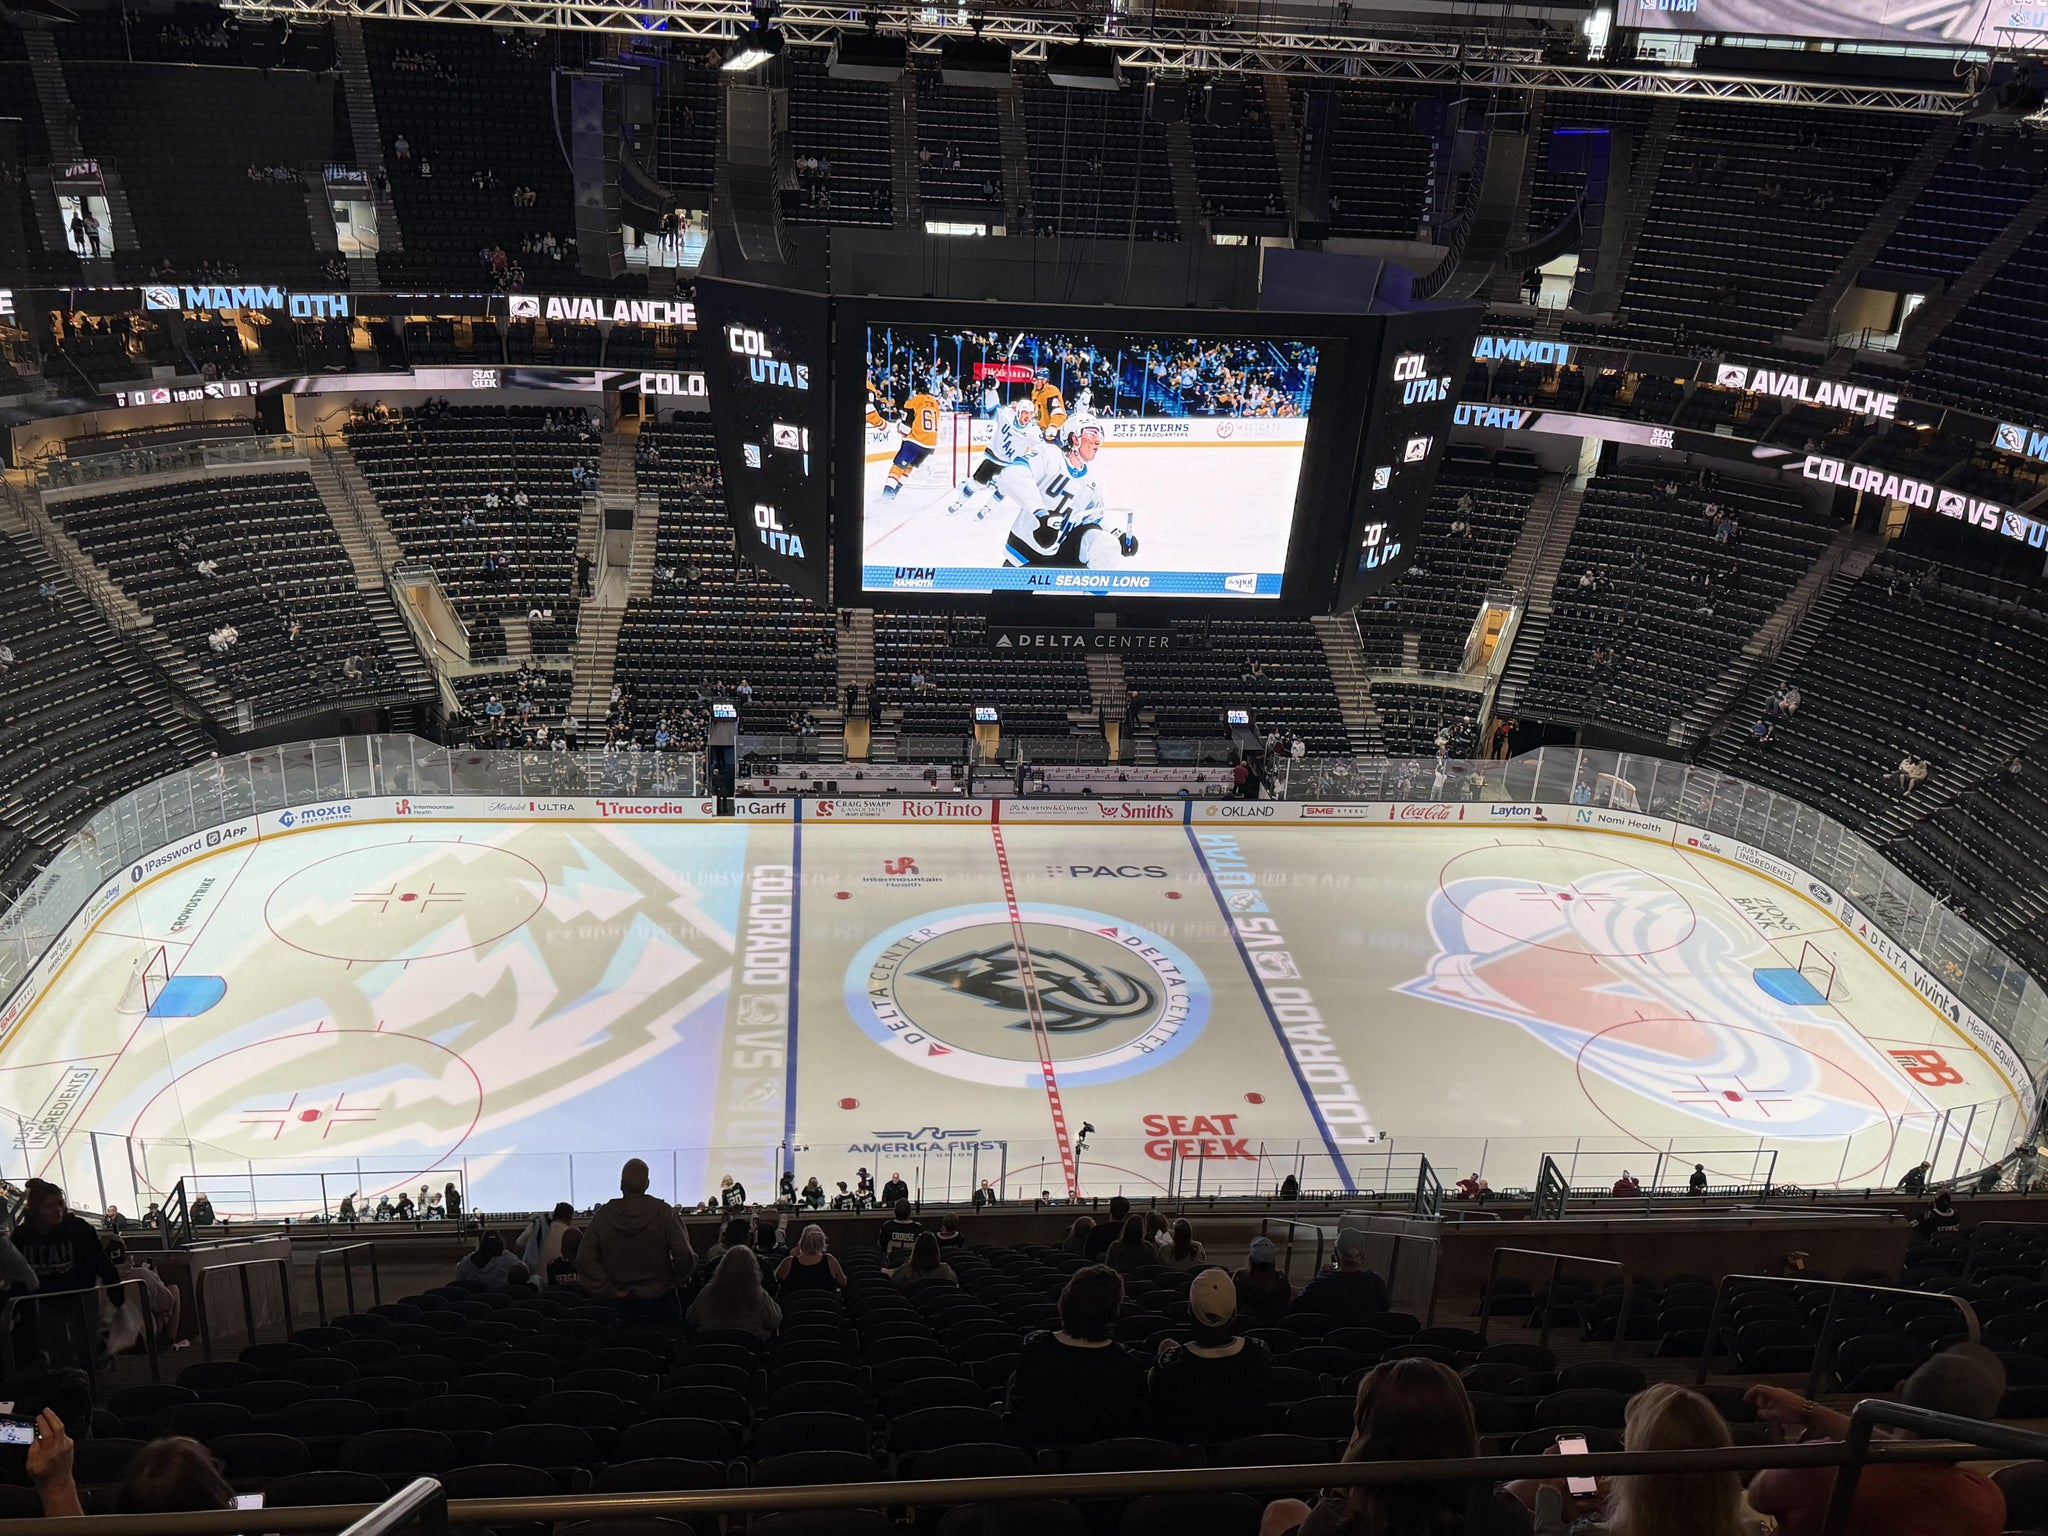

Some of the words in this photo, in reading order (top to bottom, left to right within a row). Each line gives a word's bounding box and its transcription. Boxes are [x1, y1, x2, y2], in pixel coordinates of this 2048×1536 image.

[546, 297, 697, 325] AVALANCHE
[730, 327, 772, 357] COL
[472, 370, 496, 379] SEAT
[1394, 355, 1427, 381] COL
[472, 379, 497, 388] GEEK
[640, 373, 708, 396] COLO
[173, 389, 204, 402] 18:00
[1750, 370, 1898, 420] AVALANCHE
[1453, 404, 1521, 430] UTAH
[1139, 424, 1190, 432] TAVERNS
[1652, 428, 1675, 439] SEAT
[1650, 436, 1674, 449] GEEK
[1802, 455, 1935, 510] COLORADO
[1967, 499, 2001, 531] VS
[893, 580, 934, 588] MAMMOTH
[895, 567, 936, 580] UTAH
[1028, 575, 1052, 585] ALL
[1055, 576, 1110, 587] SEASON
[1112, 577, 1151, 588] LONG
[1019, 634, 1086, 648] DELTA
[1094, 635, 1170, 649] CENTER
[538, 803, 575, 811] ULTRA
[609, 802, 683, 815] Trucordia
[748, 802, 787, 815] Garff
[836, 800, 862, 808] CRAIG
[863, 800, 891, 808] SWAPP
[1121, 802, 1174, 819] Smith's
[1221, 806, 1274, 817] OKLAND
[1306, 807, 1334, 815] SME
[1490, 805, 1531, 818] Layton
[1598, 814, 1626, 827] Nomi
[1628, 818, 1661, 833] Health
[144, 839, 202, 874] 1Password
[1741, 845, 1759, 857] JUST
[1069, 865, 1168, 878] PACS
[1739, 851, 1792, 881] INGREDIENTS
[170, 877, 216, 931] CROWDSTRIKE
[1733, 896, 1780, 931] BANK
[742, 864, 794, 986] COLORADO
[870, 928, 938, 982] CENTER
[1123, 936, 1187, 987] DELTA
[1870, 932, 1909, 974] DELTA
[871, 986, 926, 1045] DELTA
[1132, 994, 1192, 1055] CENTER
[1966, 1015, 2018, 1078] HealthEquity
[1266, 986, 1378, 1145] COLORADO
[29, 1072, 89, 1145] INGREDIENTS
[1142, 1113, 1240, 1138] SEAT
[847, 1142, 942, 1154] AMERICA
[948, 1141, 1007, 1153] FIRST
[1144, 1138, 1259, 1162] GEEK
